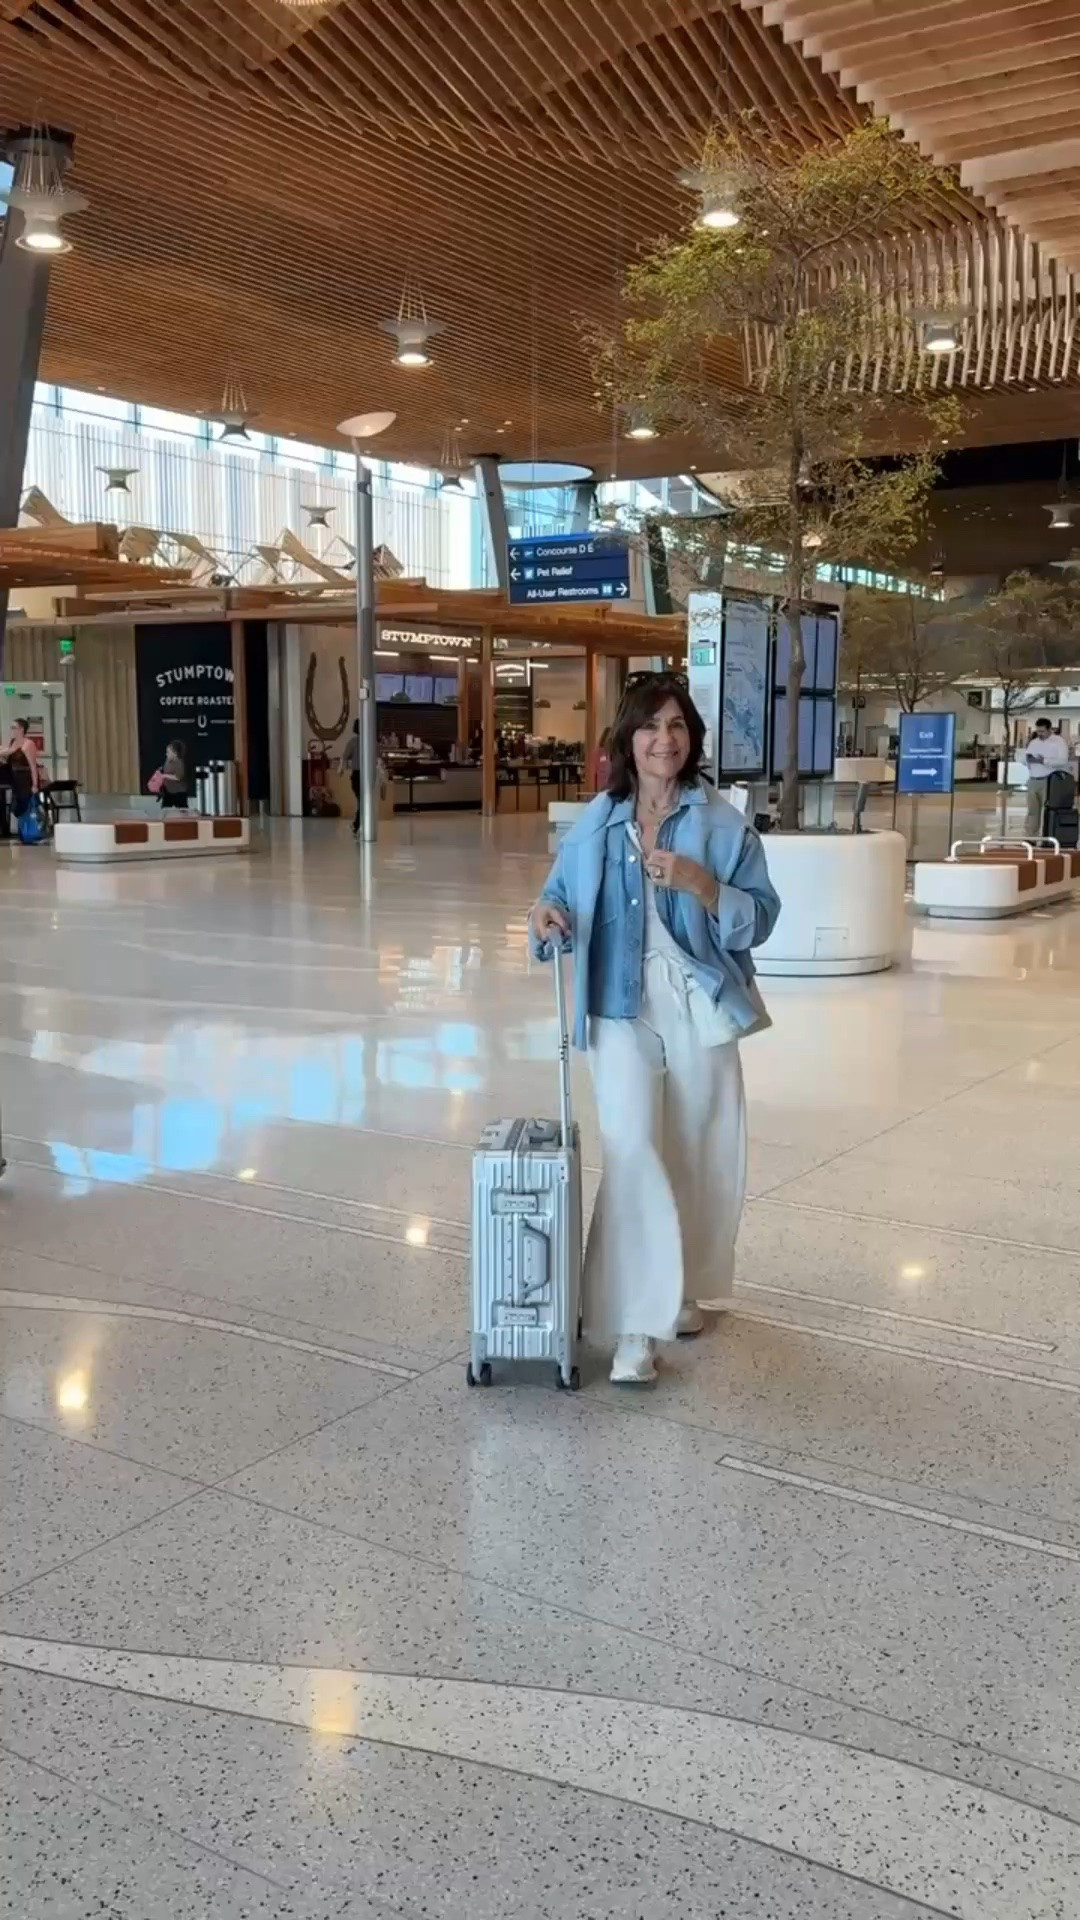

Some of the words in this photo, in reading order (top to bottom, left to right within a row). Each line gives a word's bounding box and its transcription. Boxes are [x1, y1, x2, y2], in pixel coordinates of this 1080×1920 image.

[536, 546, 577, 557] Concourse
[579, 544, 586, 553] D
[587, 544, 594, 553] E
[536, 568, 551, 577] Pet
[551, 566, 573, 576] Relief
[527, 589, 557, 598] All-User
[558, 587, 599, 596] Restrooms
[381, 629, 473, 648] STUMPTOWN
[156, 664, 234, 688] STUMPTOW
[160, 696, 195, 706] COFFEE
[197, 696, 234, 706] ROASTE
